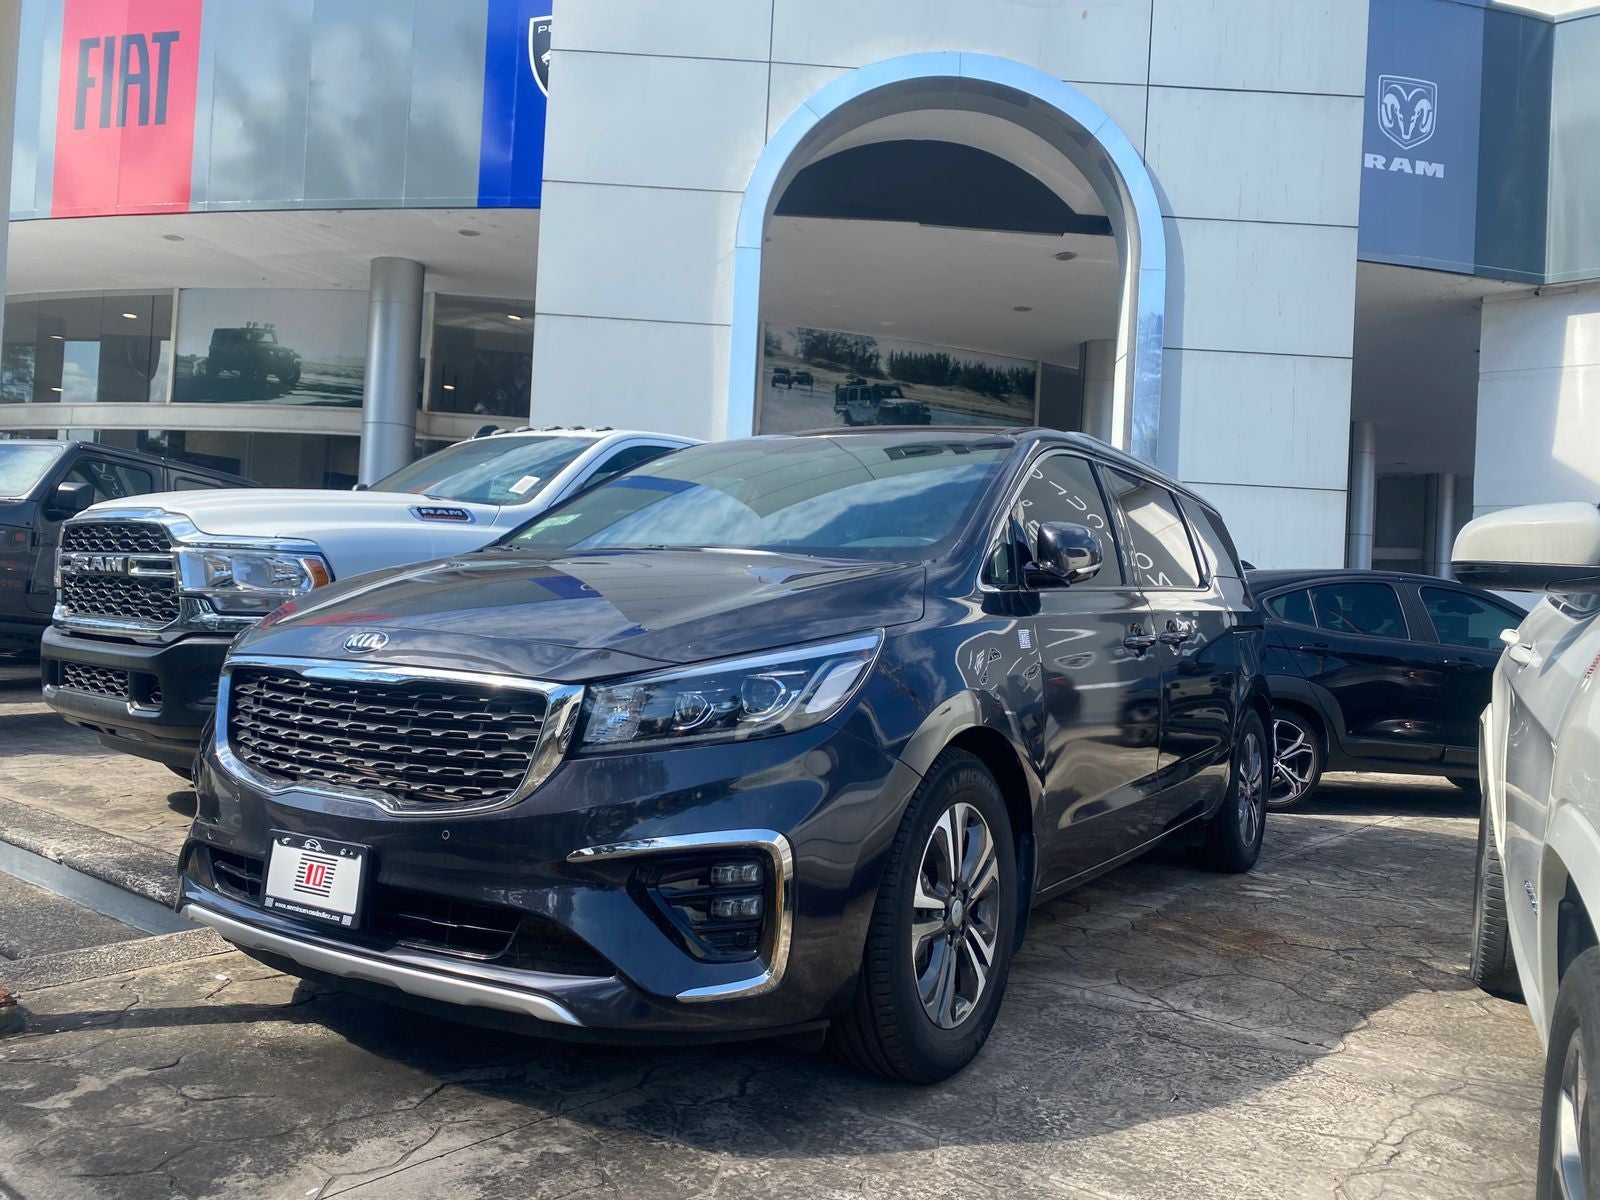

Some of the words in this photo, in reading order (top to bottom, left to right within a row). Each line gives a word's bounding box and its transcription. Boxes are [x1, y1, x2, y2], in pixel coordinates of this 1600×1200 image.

[74, 31, 180, 130] FIAT
[1364, 153, 1444, 178] RAM
[421, 508, 463, 516] RAM
[71, 556, 124, 572] RAM
[347, 633, 381, 649] KIA
[304, 863, 326, 887] 10
